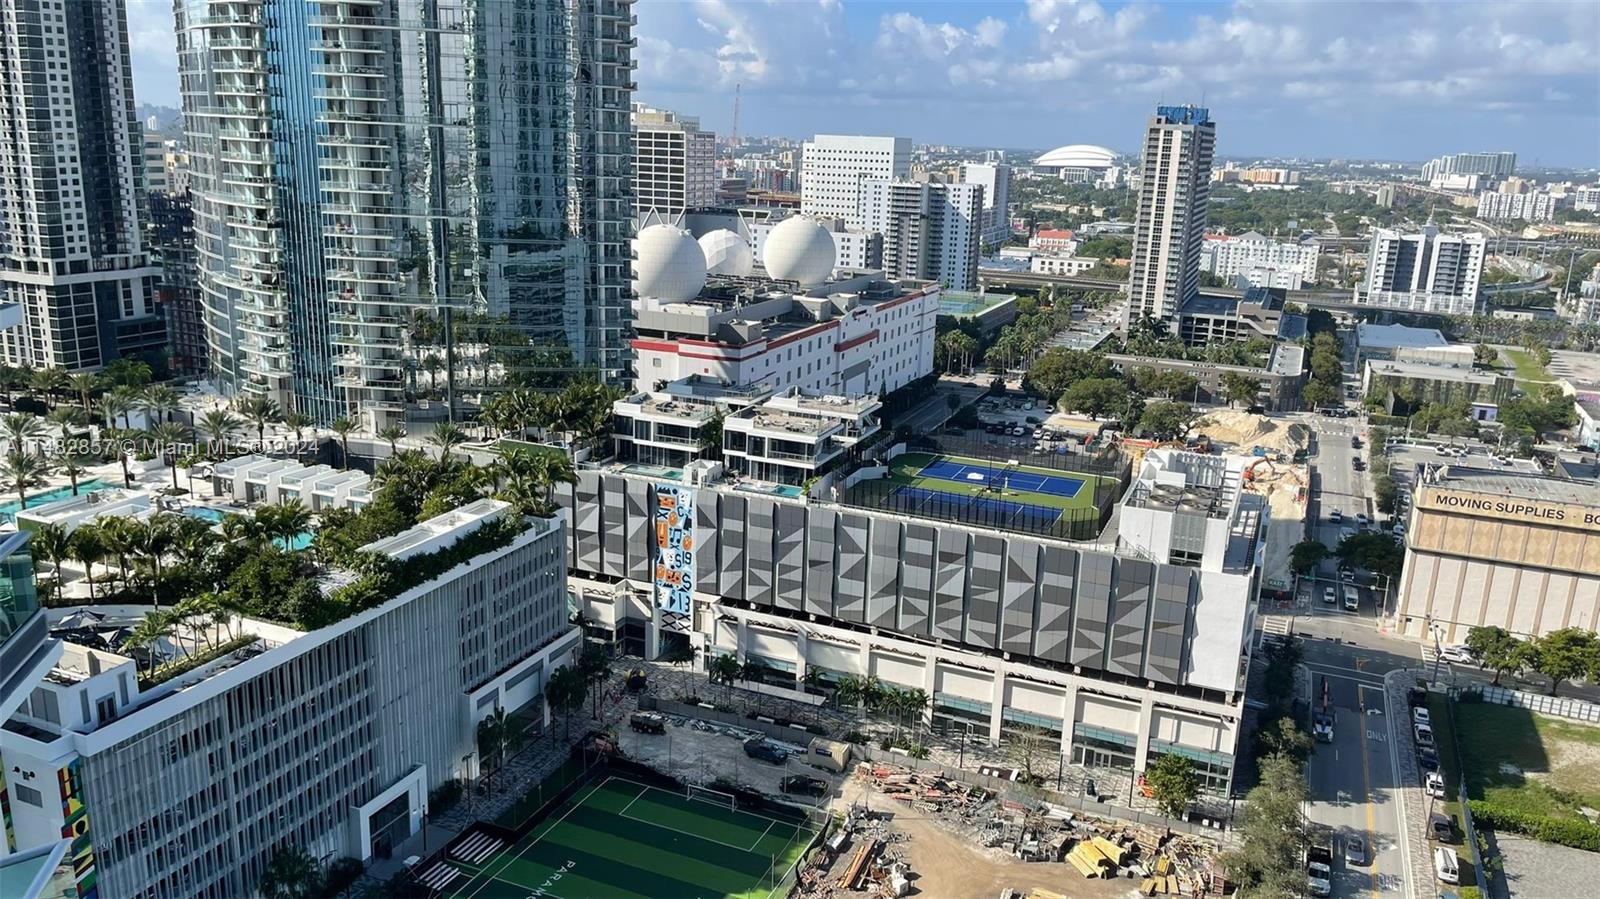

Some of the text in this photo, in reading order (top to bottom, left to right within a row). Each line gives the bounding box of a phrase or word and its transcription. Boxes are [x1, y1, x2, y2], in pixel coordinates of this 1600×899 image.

[1435, 495, 1492, 511] MOVING
[1495, 502, 1565, 520] SUPPLIES
[1366, 729, 1388, 742] ONLY
